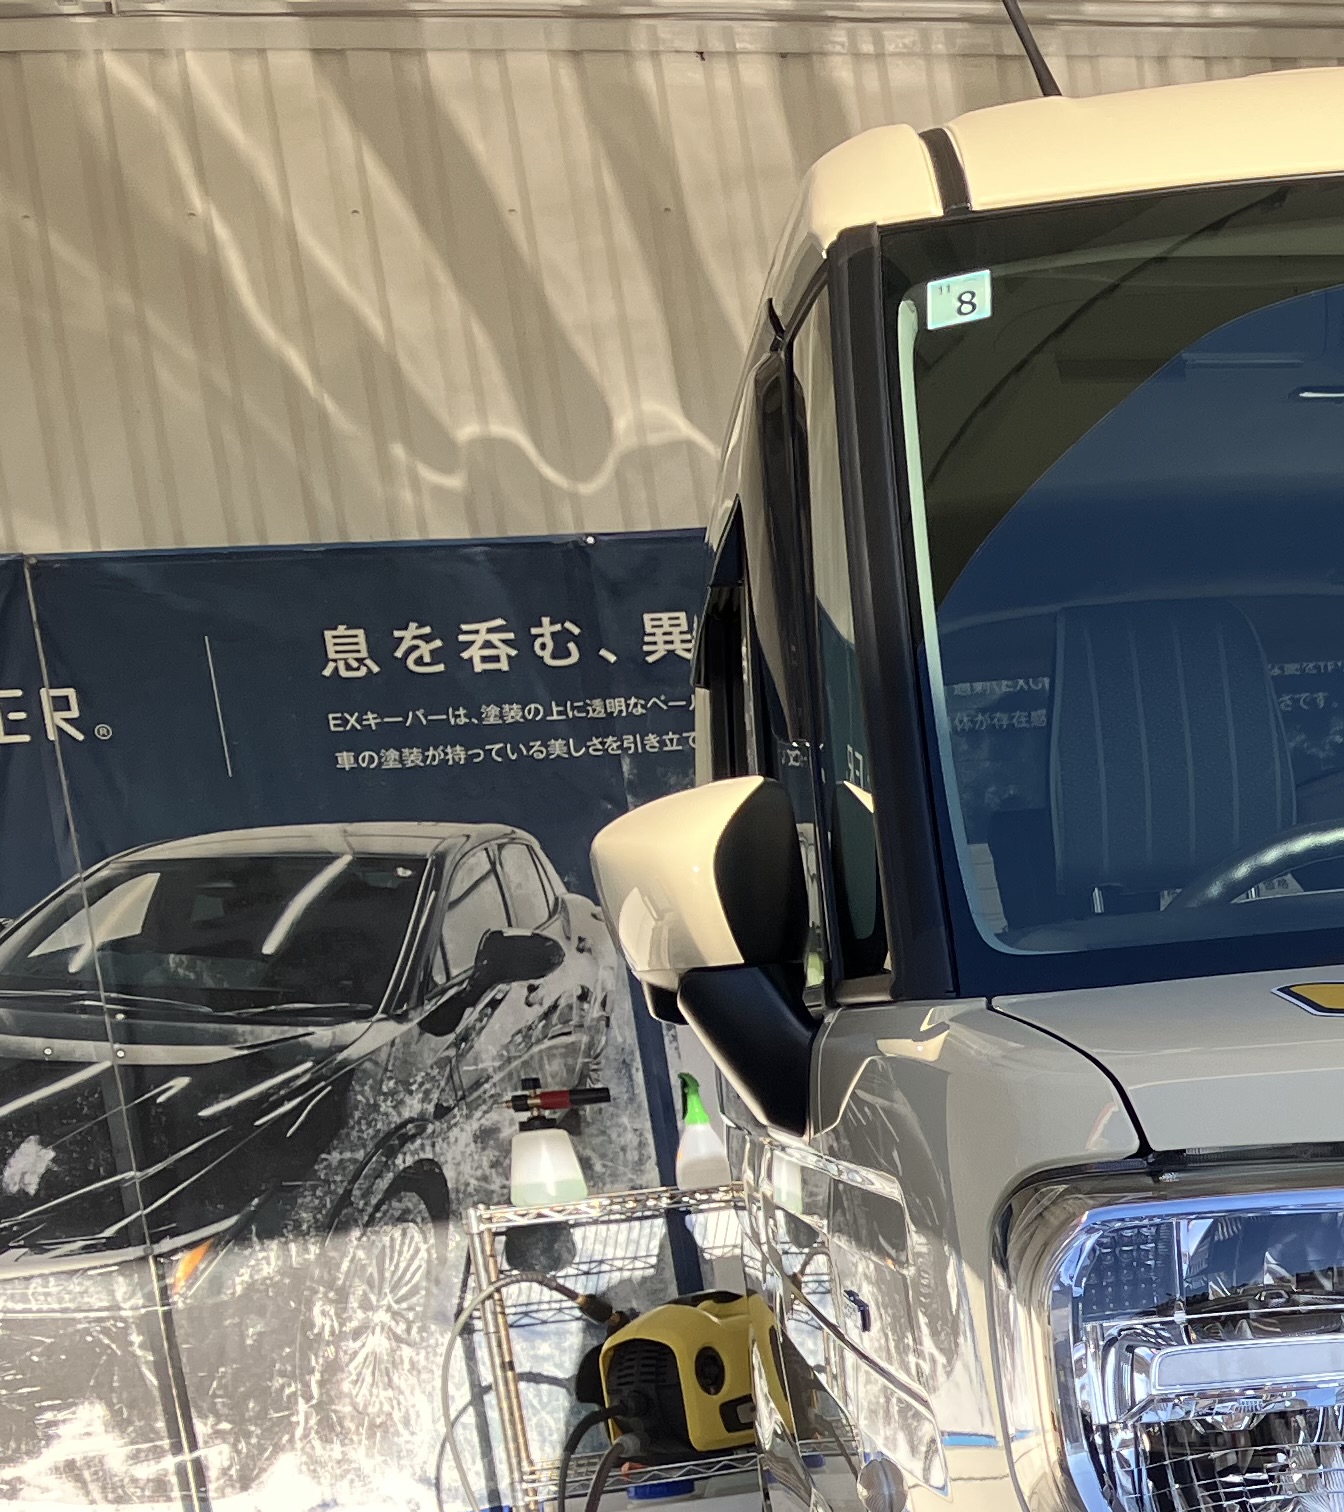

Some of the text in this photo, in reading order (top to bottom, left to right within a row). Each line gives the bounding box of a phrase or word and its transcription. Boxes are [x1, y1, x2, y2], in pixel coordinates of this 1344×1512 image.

[957, 290, 977, 316] 8
[321, 611, 695, 679] 息を呑む、異
